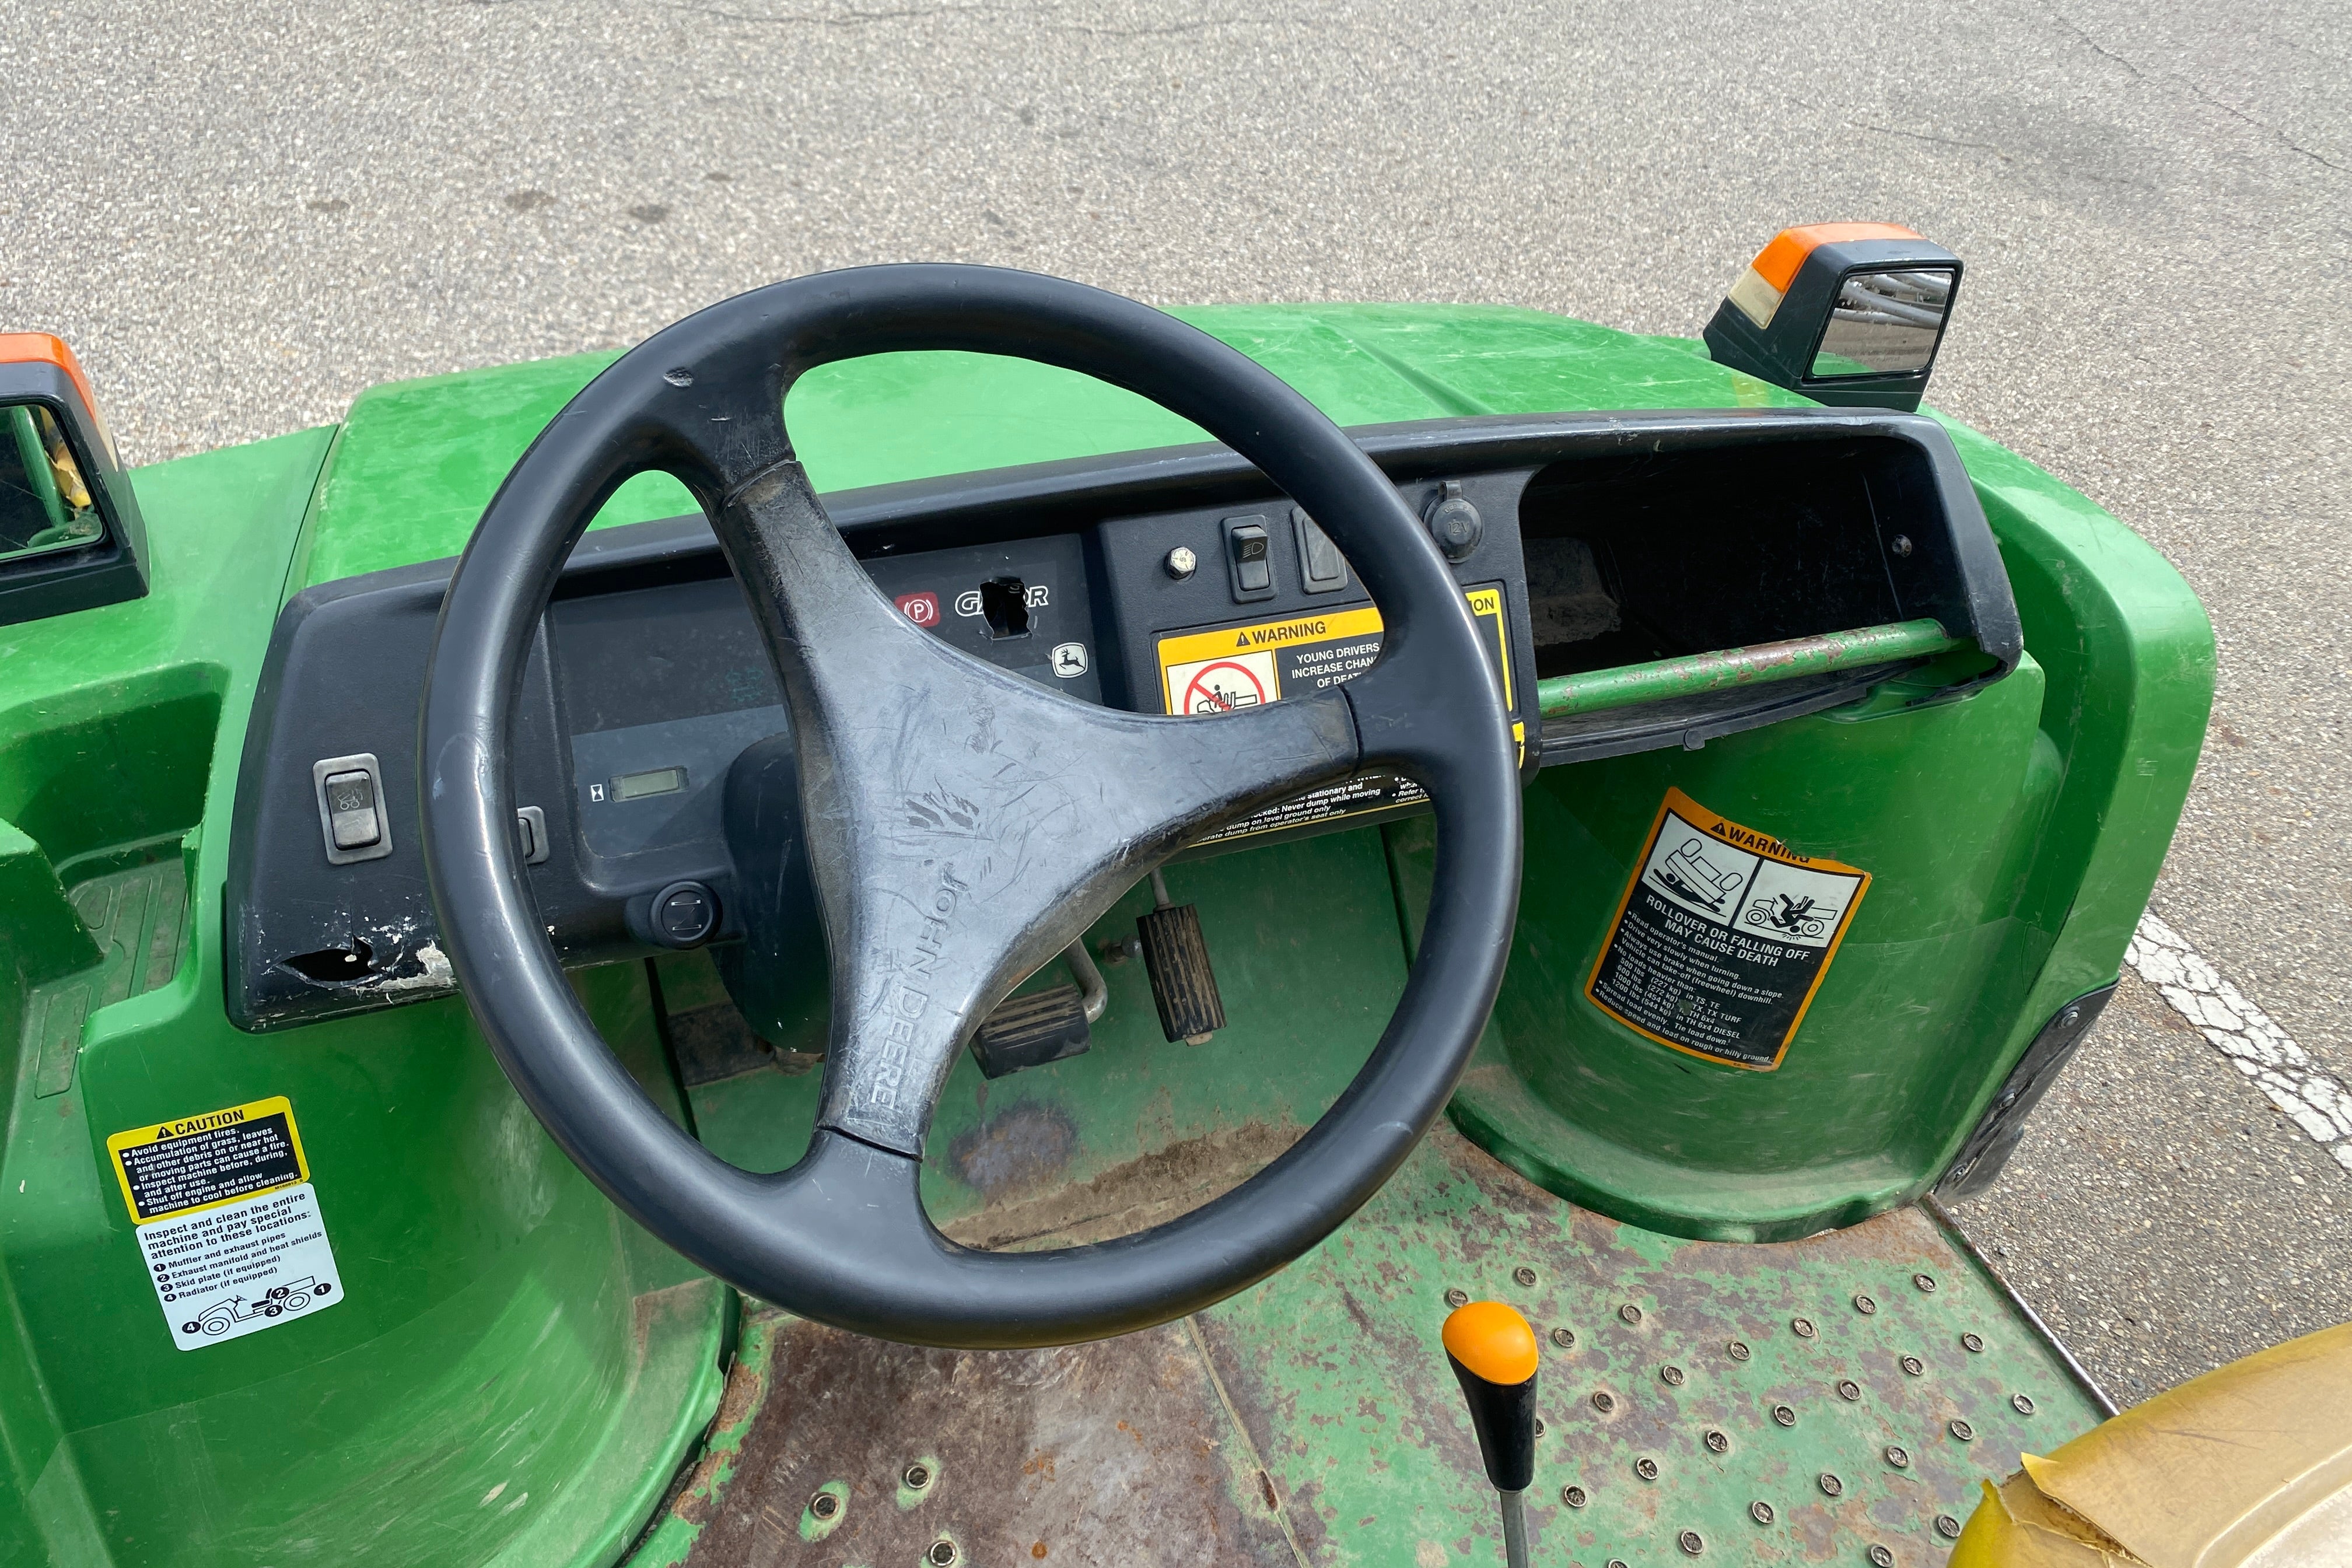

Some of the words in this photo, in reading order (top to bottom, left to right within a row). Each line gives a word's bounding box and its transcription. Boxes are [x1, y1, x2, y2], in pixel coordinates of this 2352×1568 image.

[1448, 522, 1469, 534] 12V
[1252, 621, 1326, 644] WARNING
[1292, 662, 1343, 679] INCREASE
[1345, 656, 1377, 670] CHAN
[1296, 650, 1334, 664] YOUNG
[1336, 642, 1380, 659] DRIVERS
[1317, 678, 1331, 688] OF
[1282, 802, 1305, 813] Never
[1306, 798, 1329, 808] dump
[1330, 794, 1350, 803] while
[1352, 788, 1381, 799] moving
[1348, 782, 1363, 792] and
[1395, 794, 1424, 803] correct
[1398, 789, 1419, 797] Refer
[1224, 828, 1248, 836] dump
[1250, 824, 1268, 832] from
[1270, 817, 1309, 828] operator's
[1264, 814, 1283, 823] level
[1283, 808, 1312, 820] ground
[908, 861, 969, 980] JOHN
[1632, 913, 1649, 929] Read
[1650, 927, 1687, 950] operator's
[1688, 947, 1720, 963] manual.
[1646, 895, 1707, 933] ROLLOVER
[1710, 928, 1728, 942] OR
[1730, 935, 1783, 956] FALLING
[1786, 949, 1810, 960] OFF
[1628, 922, 1646, 937] Drive
[1647, 935, 1662, 949] very
[1663, 945, 1688, 961] slowly
[1689, 957, 1709, 970] when
[1712, 965, 1741, 980] turning.
[1665, 919, 1693, 938] MAY
[1694, 934, 1735, 956] CAUSE
[1737, 949, 1779, 967] DEATH
[1618, 946, 1627, 956] No
[1628, 954, 1647, 970] loads
[1648, 966, 1676, 984] heavier
[1676, 981, 1696, 992] than:
[1620, 957, 1633, 970] 500
[1651, 977, 1668, 988] (227
[1710, 1001, 1721, 1010] TE
[1622, 937, 1646, 958] Vehicle
[1647, 956, 1660, 967] can
[1662, 963, 1692, 981] take-off
[1692, 977, 1737, 998] (freewheel)
[1738, 992, 1773, 1005] downhill.
[1624, 930, 1648, 951] Always
[1649, 948, 1662, 958] use
[1664, 954, 1685, 970] brake
[1686, 965, 1707, 978] when
[1708, 973, 1730, 987] going
[1732, 982, 1753, 992] down
[1761, 989, 1784, 999] slope.
[1603, 982, 1626, 1002] Spread
[1626, 999, 1643, 1012] load
[1643, 1009, 1669, 1026] evenly.
[1675, 1023, 1686, 1031] Tie
[1688, 1028, 1705, 1039] load
[1706, 1035, 1728, 1045] down.
[1612, 979, 1628, 993] 1200
[1641, 998, 1658, 1010] (544
[1698, 1023, 1712, 1031] 6x4
[1713, 1027, 1741, 1039] DIESEL
[1615, 972, 1631, 987] 1000
[1644, 991, 1661, 1003] (454
[1701, 1015, 1715, 1024] 6x4
[1617, 964, 1630, 977] 600
[1647, 984, 1665, 996] (272
[1721, 1013, 1742, 1024] TURF
[1599, 991, 1623, 1010] Reduce
[1624, 1009, 1646, 1024] speed
[1646, 1021, 1661, 1031] and
[1662, 1028, 1679, 1039] load
[1691, 1041, 1713, 1051] rough
[1724, 1048, 1742, 1059] hilly
[1742, 1054, 1770, 1062] ground.
[871, 985, 929, 1110] DEERE
[131, 1144, 158, 1157] Avoid
[161, 1132, 211, 1150] equipment
[214, 1128, 239, 1138] fires.
[175, 1110, 244, 1135] CAUTION
[134, 1146, 198, 1166] Accumulation
[200, 1142, 209, 1150] of
[212, 1137, 240, 1149] grass,
[243, 1128, 273, 1140] leaves
[136, 1164, 153, 1174] and
[156, 1158, 180, 1169] other
[183, 1151, 212, 1163] debris
[241, 1139, 261, 1150] near
[264, 1133, 278, 1144] hot
[152, 1164, 186, 1179] moving
[188, 1159, 212, 1172] parts
[214, 1156, 230, 1164] can
[233, 1148, 260, 1160] cause
[270, 1141, 289, 1150] fire.
[141, 1176, 176, 1189] Inspect
[178, 1167, 218, 1182] machine
[219, 1160, 253, 1172] before,
[255, 1150, 288, 1163] during,
[144, 1188, 162, 1198] and
[164, 1183, 187, 1194] after
[190, 1178, 210, 1187] use.
[146, 1196, 167, 1206] Shut
[170, 1192, 182, 1200] off
[185, 1183, 216, 1197] engine
[219, 1179, 235, 1189] and
[238, 1172, 262, 1184] allow
[149, 1199, 189, 1214] machine
[202, 1190, 222, 1201] cool
[225, 1183, 254, 1196] before
[256, 1172, 298, 1188] cleaning.
[144, 1224, 188, 1240] Inspect
[191, 1217, 212, 1230] and
[216, 1210, 247, 1224] clean
[250, 1204, 269, 1214] the
[272, 1194, 305, 1208] entire
[148, 1233, 198, 1250] machine
[202, 1225, 223, 1237] and
[227, 1220, 247, 1233] pay
[251, 1206, 292, 1224] special
[151, 1241, 203, 1259] attention
[206, 1237, 217, 1246] to
[220, 1228, 252, 1242] these
[256, 1211, 311, 1233] locations:
[169, 1255, 202, 1269] Muffler
[204, 1250, 221, 1260] and
[223, 1240, 259, 1255] exhaust
[261, 1233, 286, 1245] pipes
[172, 1265, 207, 1279] Exhaust
[209, 1254, 249, 1269] manifold
[251, 1248, 267, 1258] and
[270, 1242, 289, 1252] heat
[291, 1231, 322, 1246] shields
[176, 1278, 195, 1289] Skid
[198, 1272, 220, 1283] plate
[223, 1269, 233, 1278] (if
[236, 1255, 281, 1273] equipped)
[178, 1283, 218, 1298] Radiator
[220, 1280, 230, 1289] (if
[233, 1266, 278, 1284] equipped)
